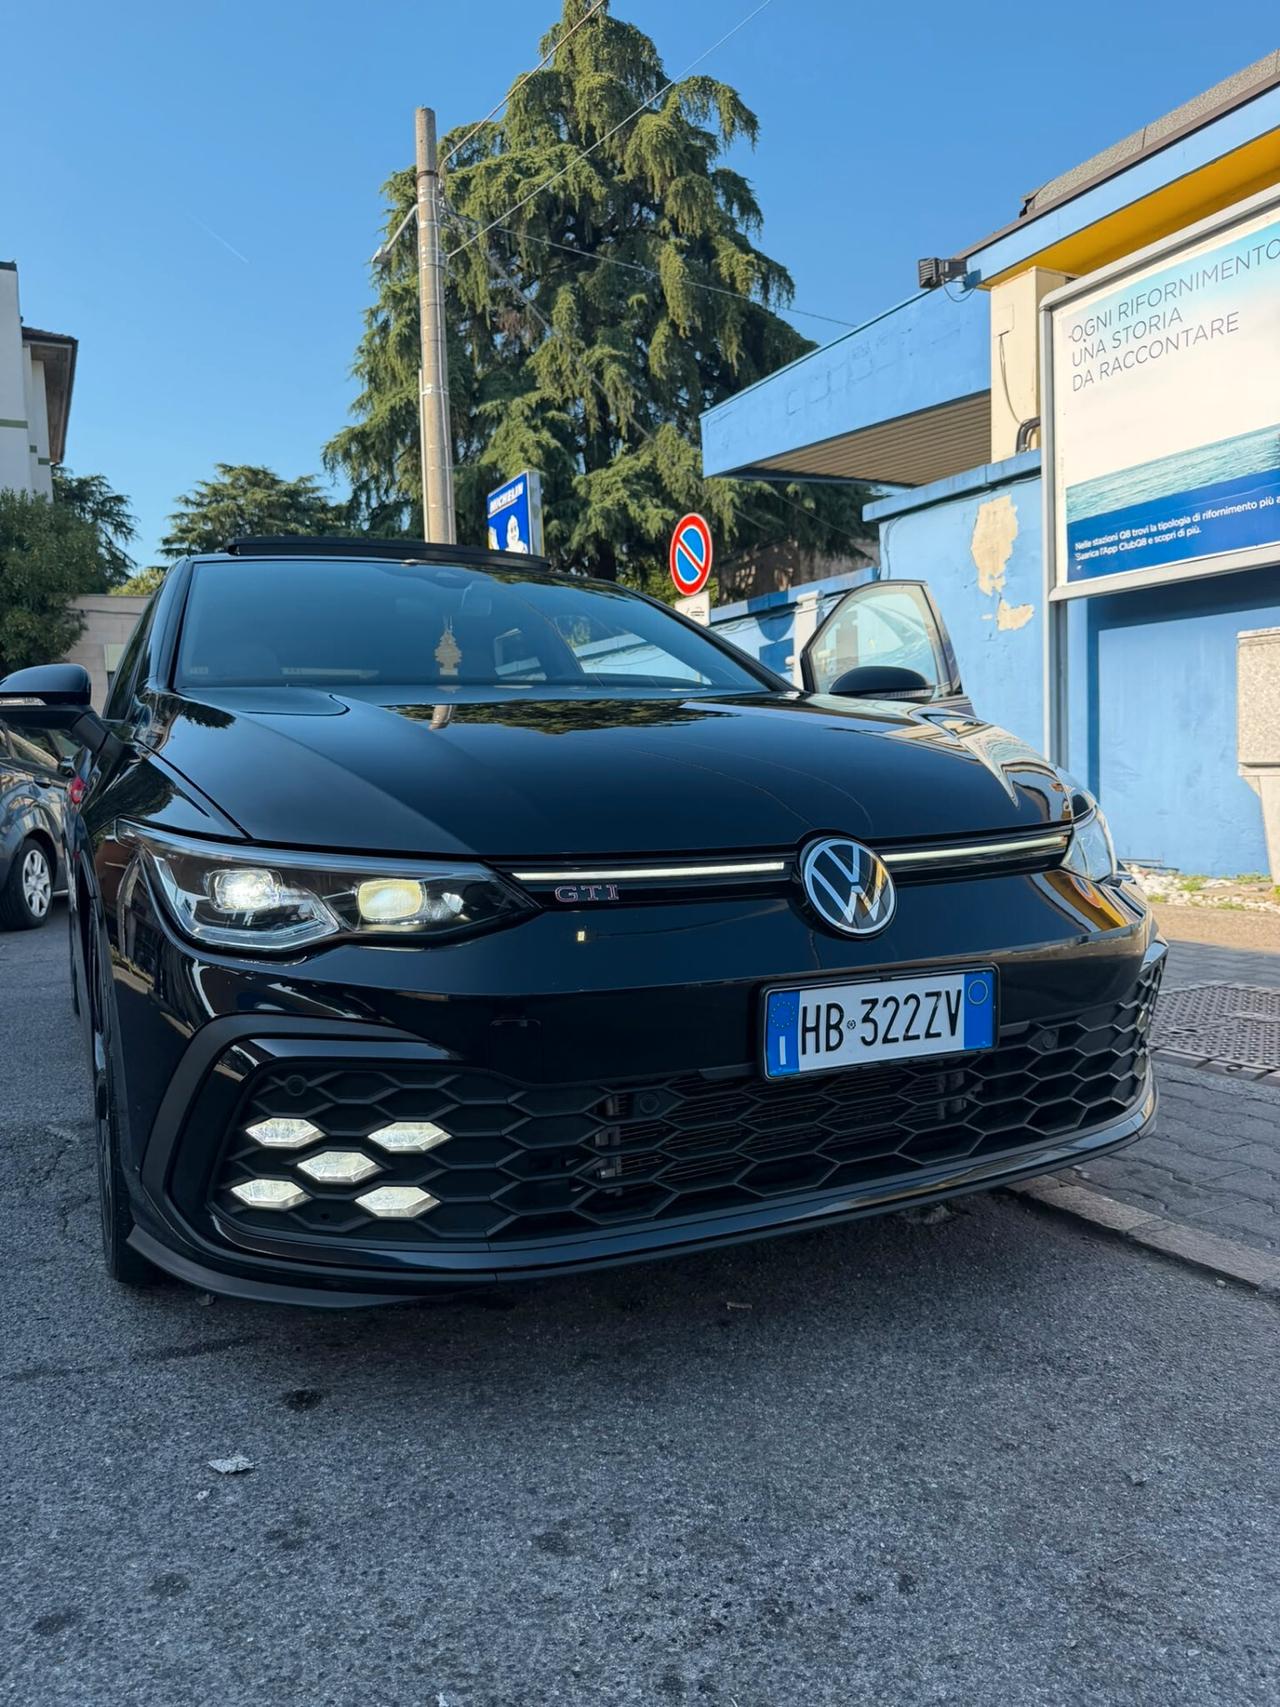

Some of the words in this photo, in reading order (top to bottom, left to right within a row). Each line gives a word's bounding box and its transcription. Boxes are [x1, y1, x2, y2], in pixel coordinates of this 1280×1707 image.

[1071, 310, 1112, 343] OGNI
[1118, 238, 1280, 321] RIFORNIMENTO
[1072, 340, 1106, 367] UNA
[1111, 307, 1183, 349] STORIA
[1072, 369, 1095, 392] DA
[1099, 312, 1240, 380] RACCONTARE
[490, 482, 523, 513] MICHELIN
[1075, 540, 1092, 550] Nelle
[1092, 533, 1118, 546] stazioni
[1132, 525, 1149, 536] trovi
[1150, 524, 1157, 532] la
[1158, 516, 1191, 532] tipologia
[1192, 512, 1201, 522] di
[1202, 501, 1258, 519] rifornimento
[1259, 496, 1274, 509] più
[1119, 537, 1147, 551] ClubQ8
[1154, 532, 1176, 544] scopri
[1177, 528, 1185, 538] di
[1186, 524, 1202, 537] più.
[554, 884, 620, 902] GTI
[801, 1002, 844, 1055] HB
[860, 989, 962, 1047] 322ZV
